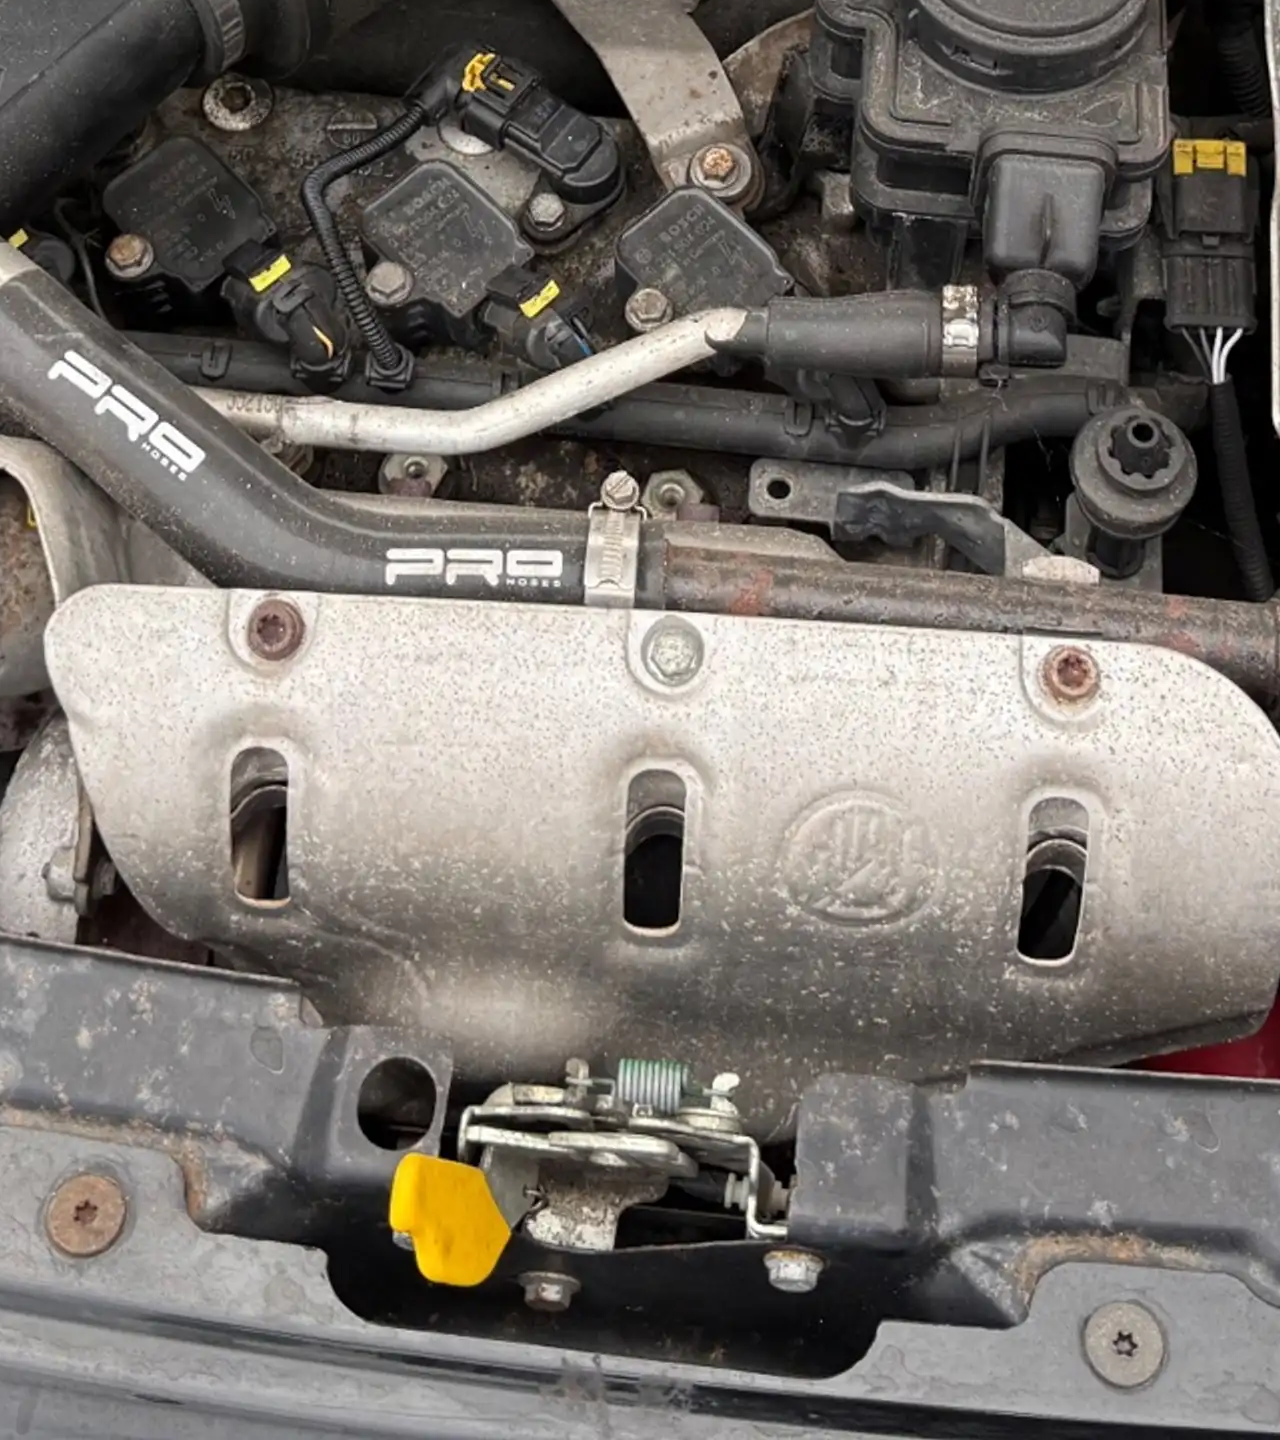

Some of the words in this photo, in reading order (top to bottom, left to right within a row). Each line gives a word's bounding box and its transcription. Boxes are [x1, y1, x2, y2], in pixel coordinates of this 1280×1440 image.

[47, 350, 207, 474] PRO
[385, 548, 564, 587] PRO
[505, 577, 562, 589] HOSES
